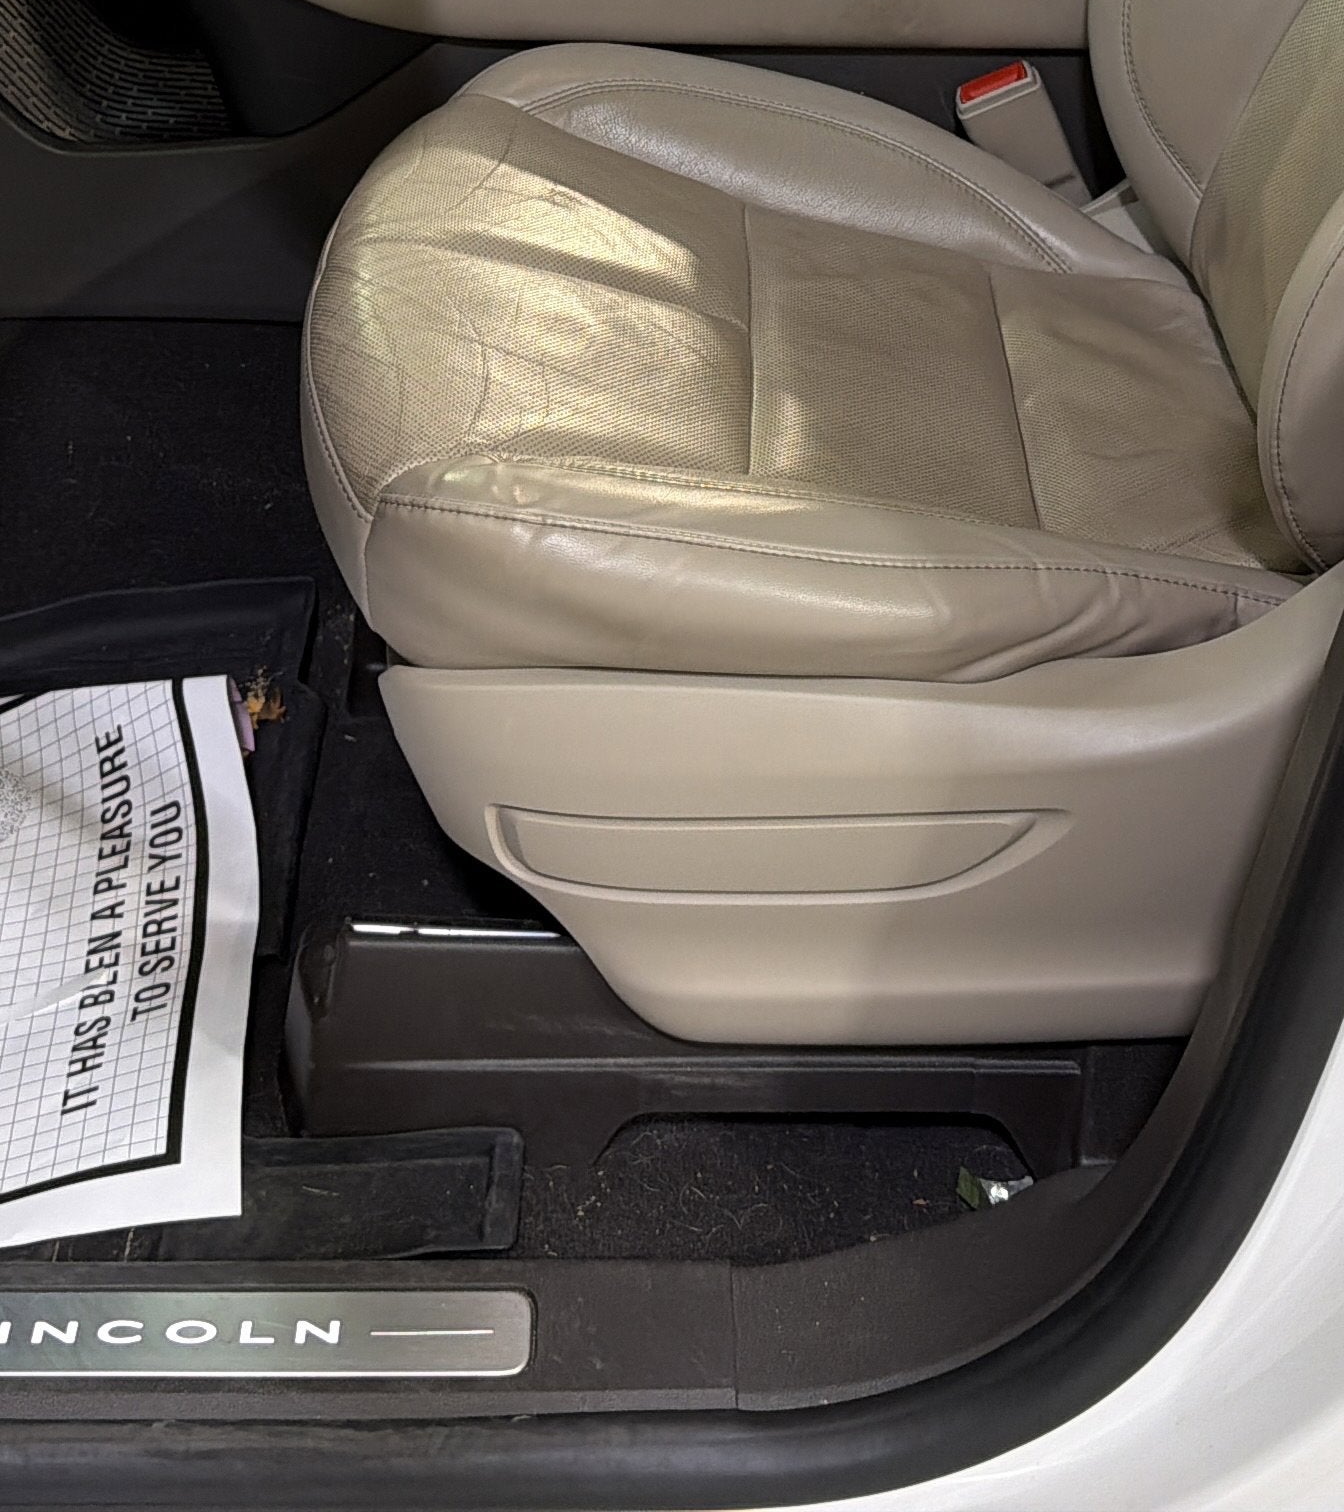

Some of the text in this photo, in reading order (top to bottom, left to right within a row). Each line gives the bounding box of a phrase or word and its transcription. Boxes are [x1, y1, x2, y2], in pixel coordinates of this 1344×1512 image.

[93, 724, 133, 896] PLEASURE
[91, 899, 126, 921] A
[130, 800, 183, 1022] TO SERVE YOU
[66, 1015, 112, 1078] HAS
[61, 1085, 100, 1116] IT
